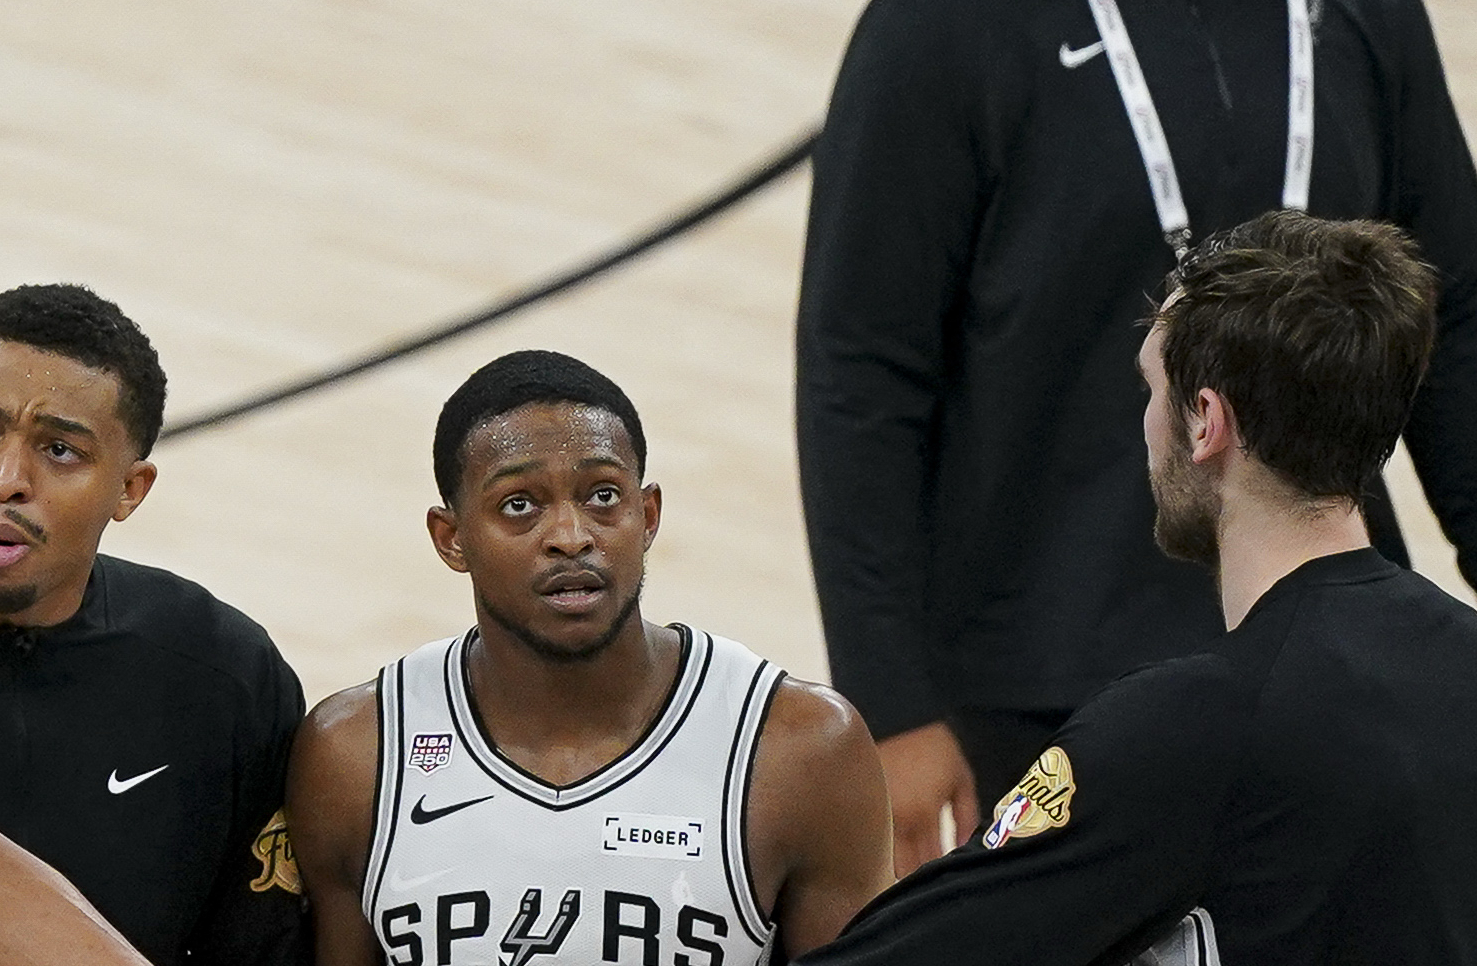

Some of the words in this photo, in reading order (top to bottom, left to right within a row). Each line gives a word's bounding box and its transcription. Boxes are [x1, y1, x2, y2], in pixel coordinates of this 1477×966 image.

[416, 736, 450, 747] USA
[410, 753, 449, 766] 250
[616, 827, 689, 847] LEDGER
